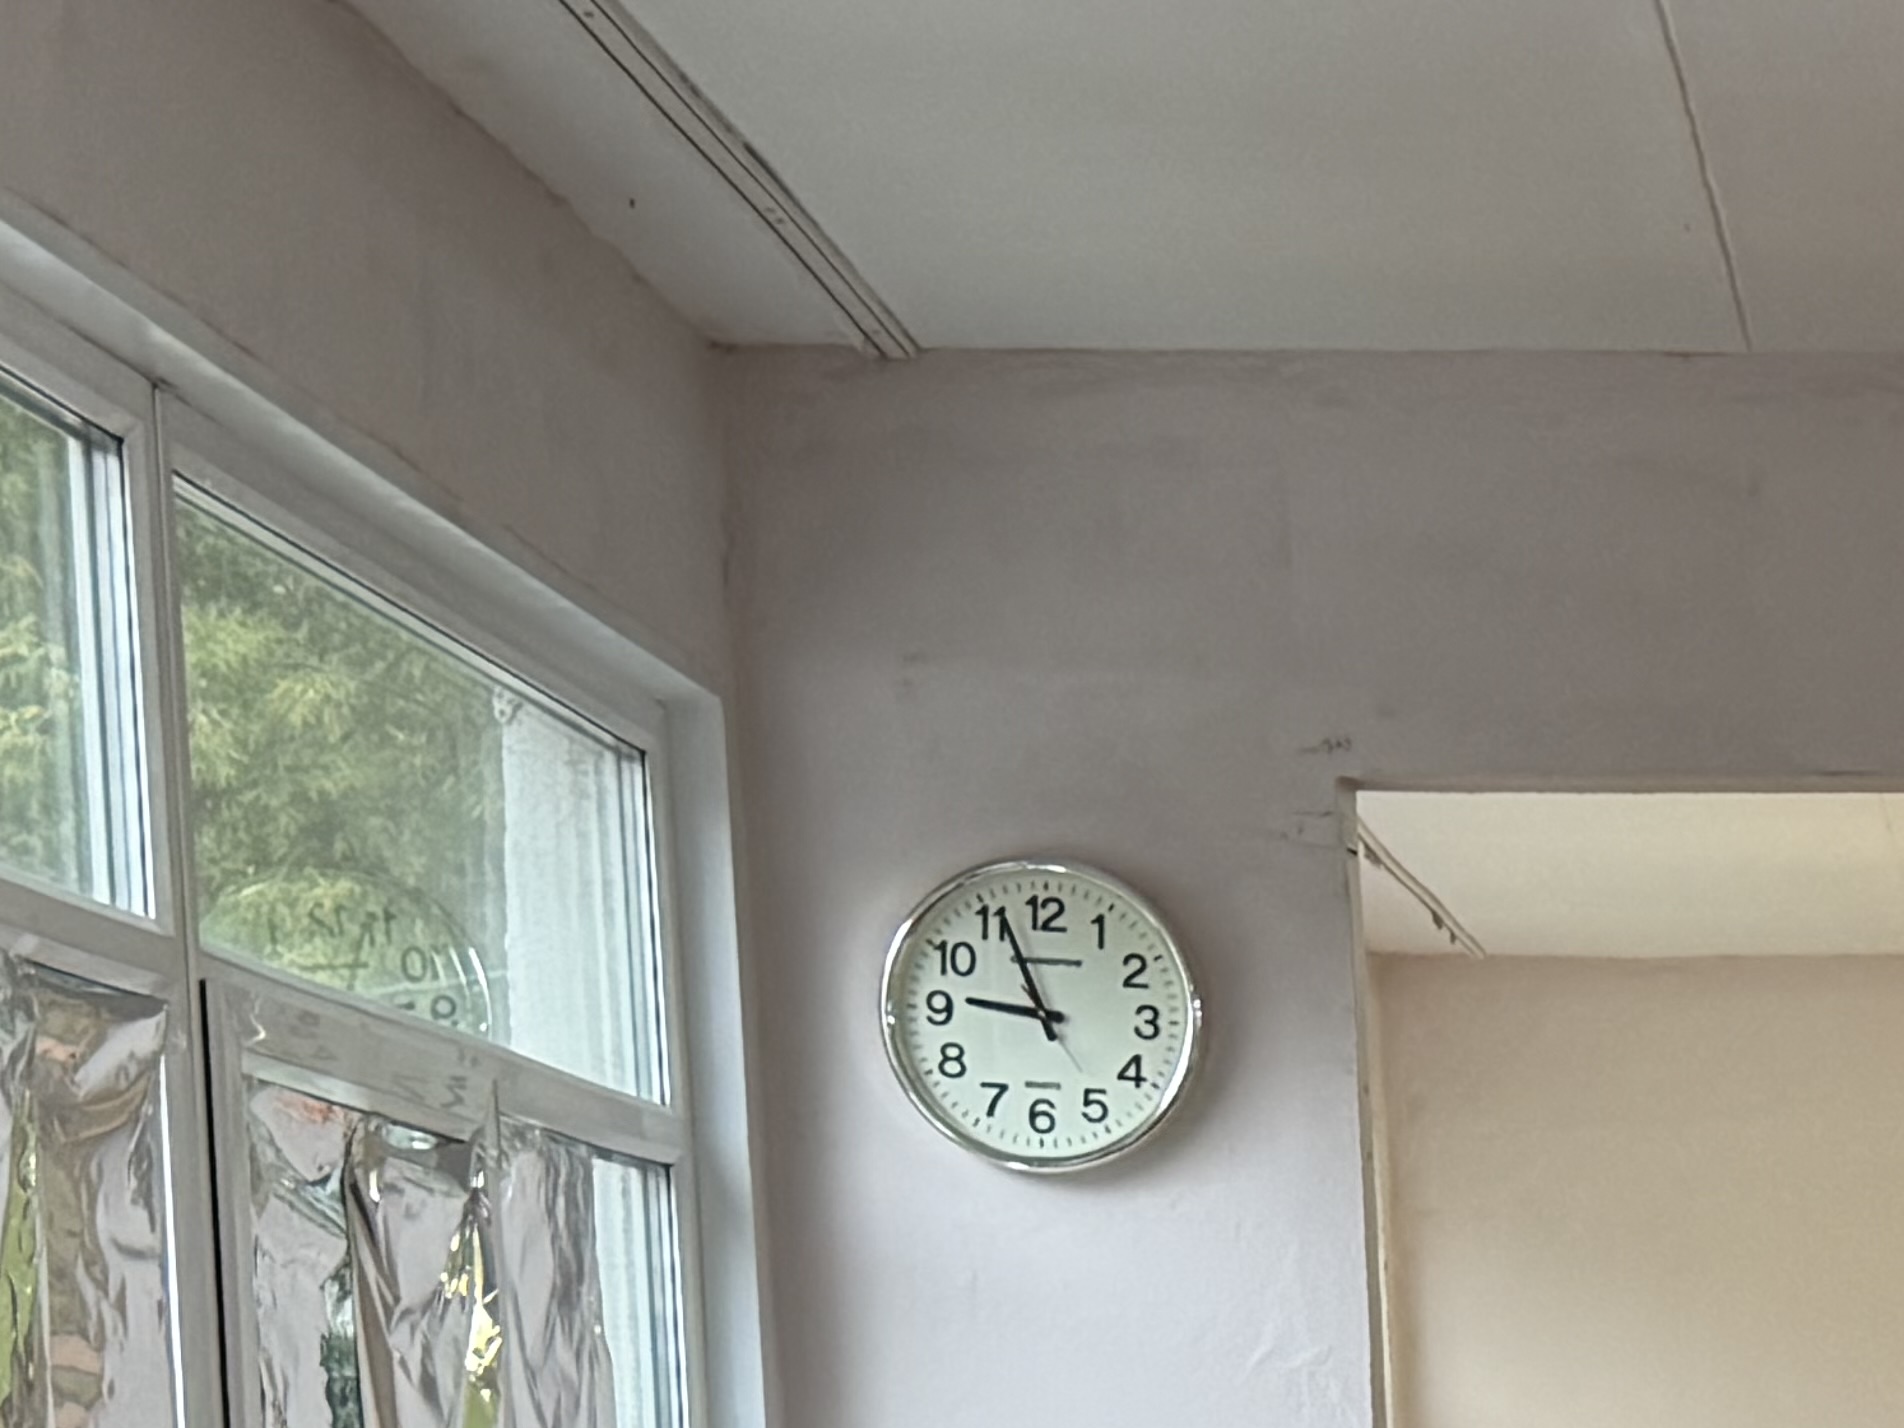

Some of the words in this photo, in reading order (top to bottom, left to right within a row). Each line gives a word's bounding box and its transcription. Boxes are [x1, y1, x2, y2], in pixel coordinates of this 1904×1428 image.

[975, 905, 1007, 941] 11
[1025, 895, 1067, 933] 12
[1091, 914, 1106, 950] 1
[934, 940, 977, 977] 10
[1122, 953, 1150, 989] 2
[925, 990, 954, 1025] 9
[1133, 1004, 1161, 1040] 3
[938, 1042, 967, 1079] 8
[1117, 1054, 1147, 1089] 4
[979, 1082, 1009, 1118] 7
[1028, 1098, 1056, 1134] 6
[1081, 1088, 1109, 1124] 5
